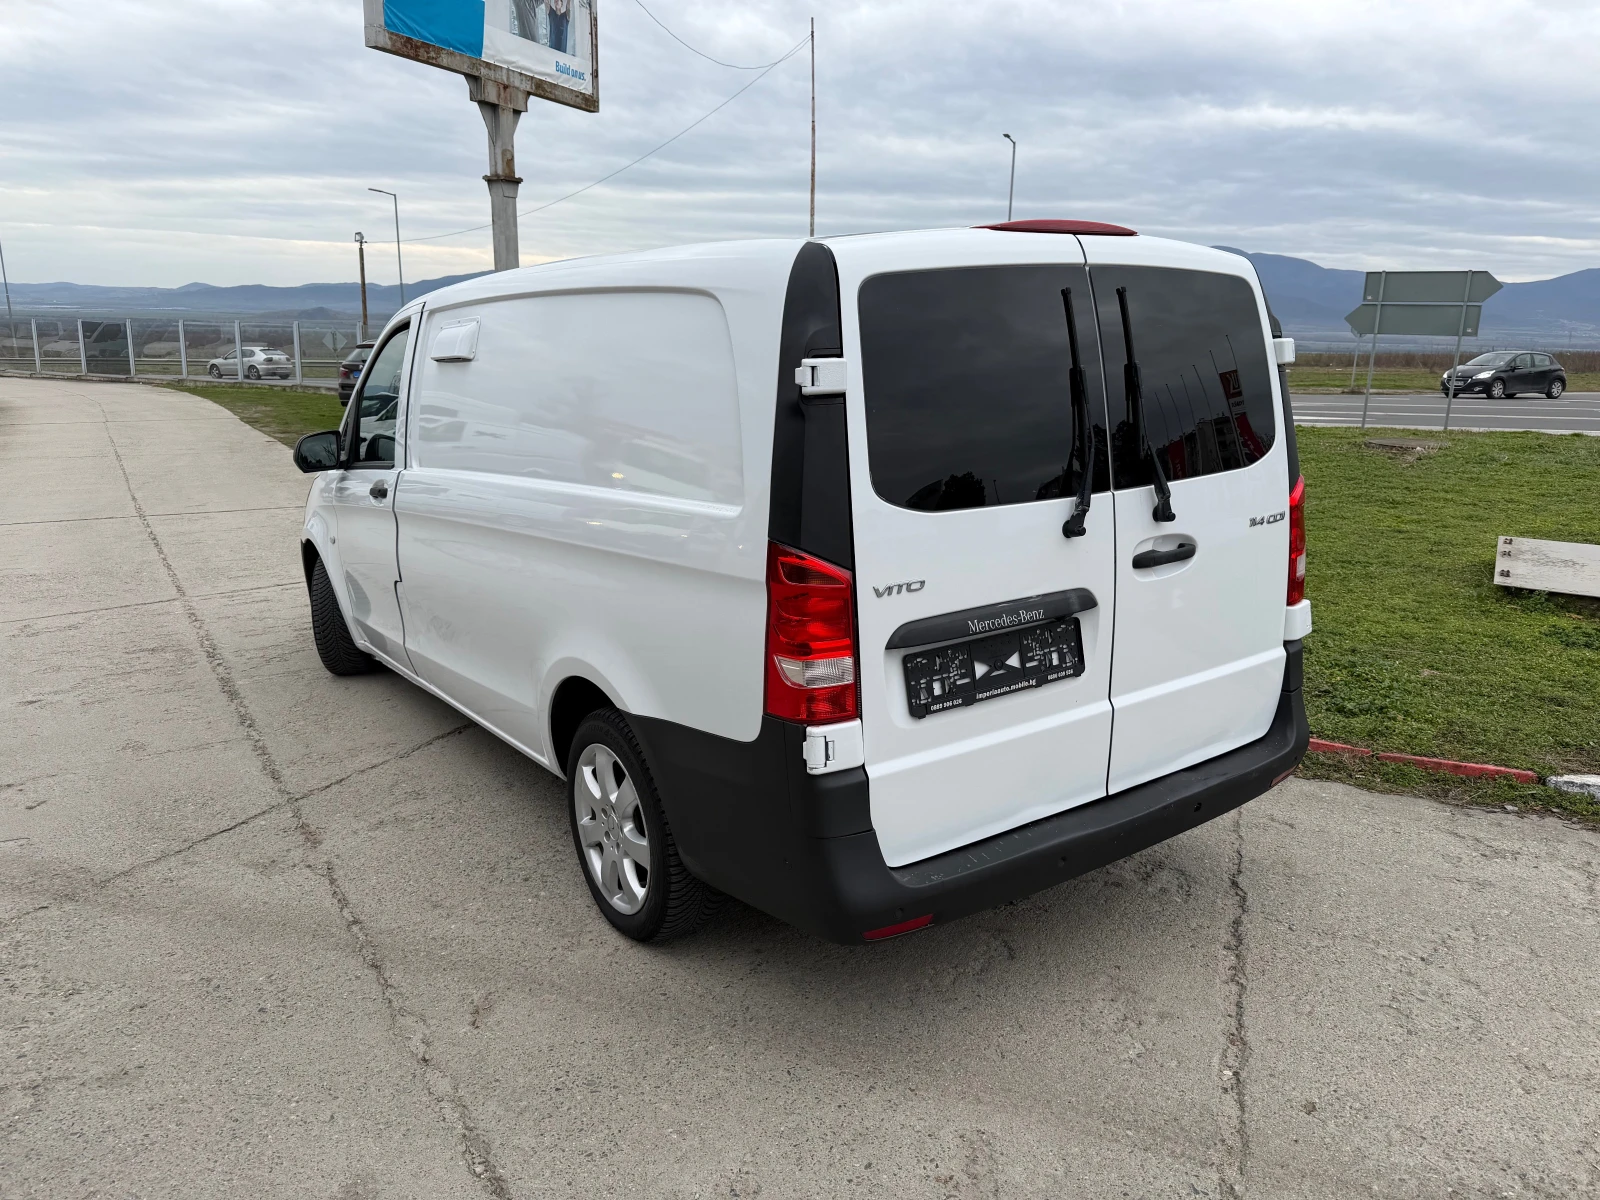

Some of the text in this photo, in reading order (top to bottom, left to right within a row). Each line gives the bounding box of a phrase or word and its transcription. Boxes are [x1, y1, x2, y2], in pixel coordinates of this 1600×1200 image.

[555, 60, 571, 76] Build
[872, 579, 926, 599] VITO
[967, 609, 1045, 634] Mercedes-Benz
